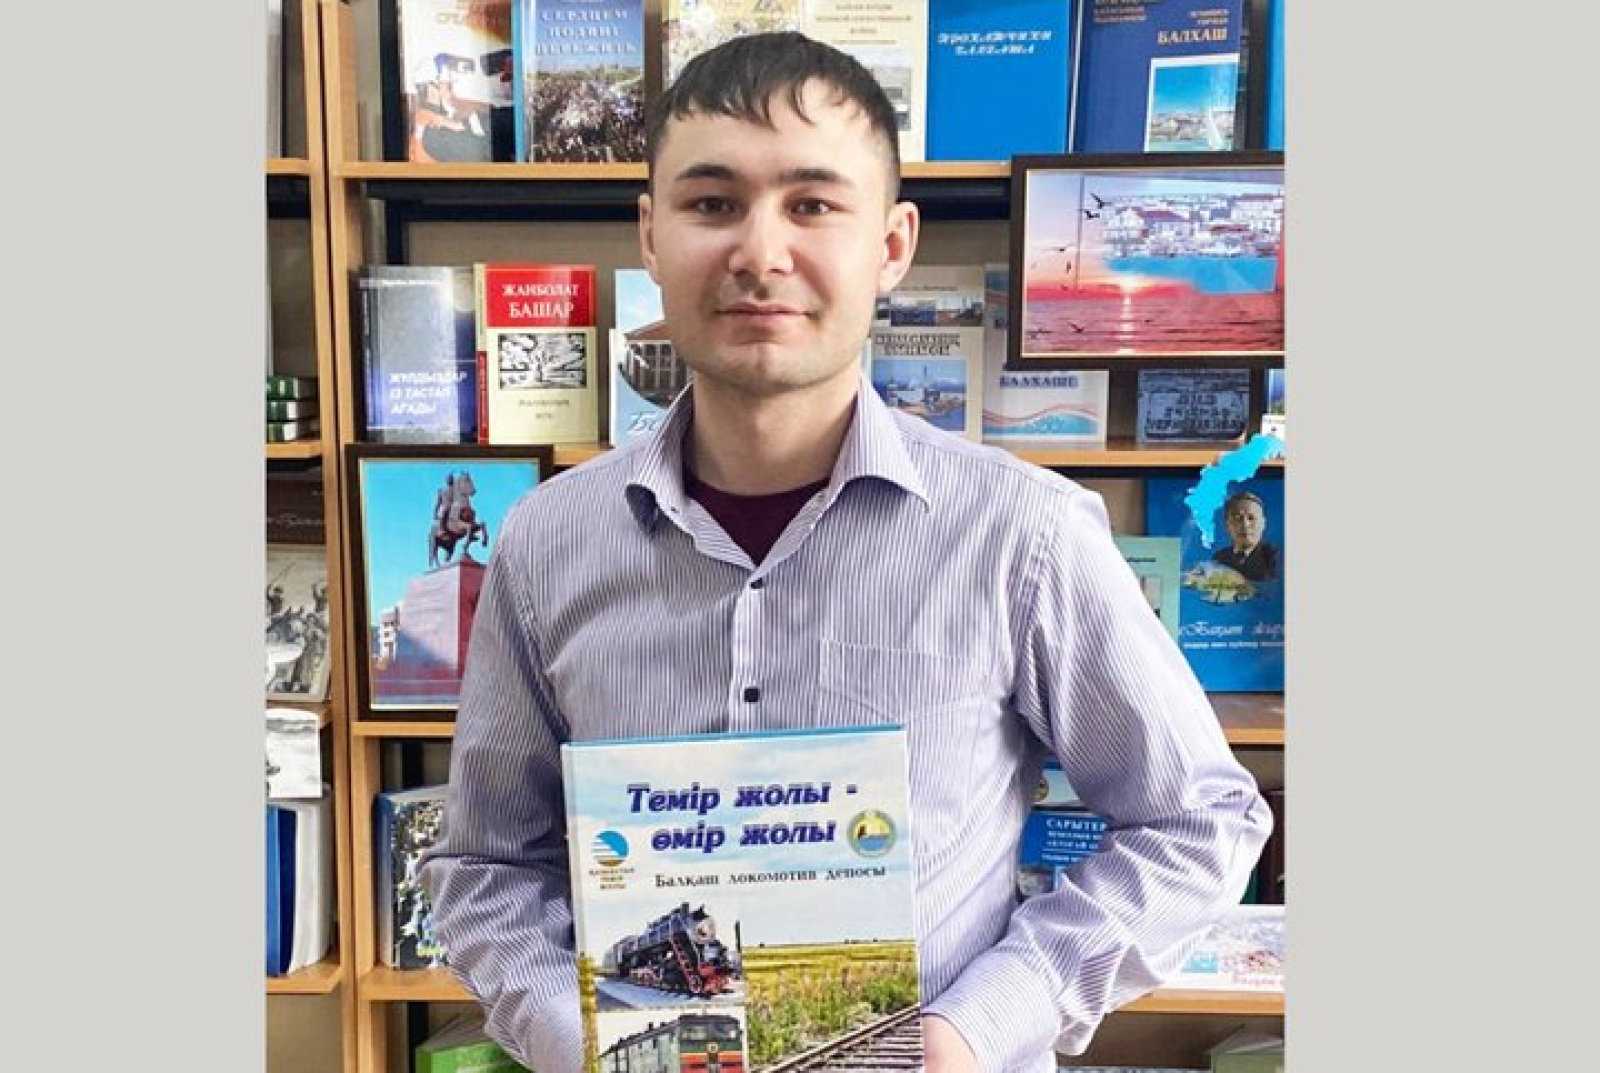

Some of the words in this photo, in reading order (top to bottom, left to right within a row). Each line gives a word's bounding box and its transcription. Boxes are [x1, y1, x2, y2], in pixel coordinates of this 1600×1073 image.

[1157, 28, 1228, 45] БАЛХАШ
[502, 284, 579, 297] ЖАНБОЛАТ
[509, 301, 575, 318] БАШАР
[627, 782, 721, 815] Темір
[734, 782, 831, 810] жолы
[651, 820, 726, 854] өмір
[739, 821, 837, 847] жолы
[655, 873, 720, 889] Балқаш
[728, 870, 817, 885] локомотив
[825, 866, 886, 881] депосы
